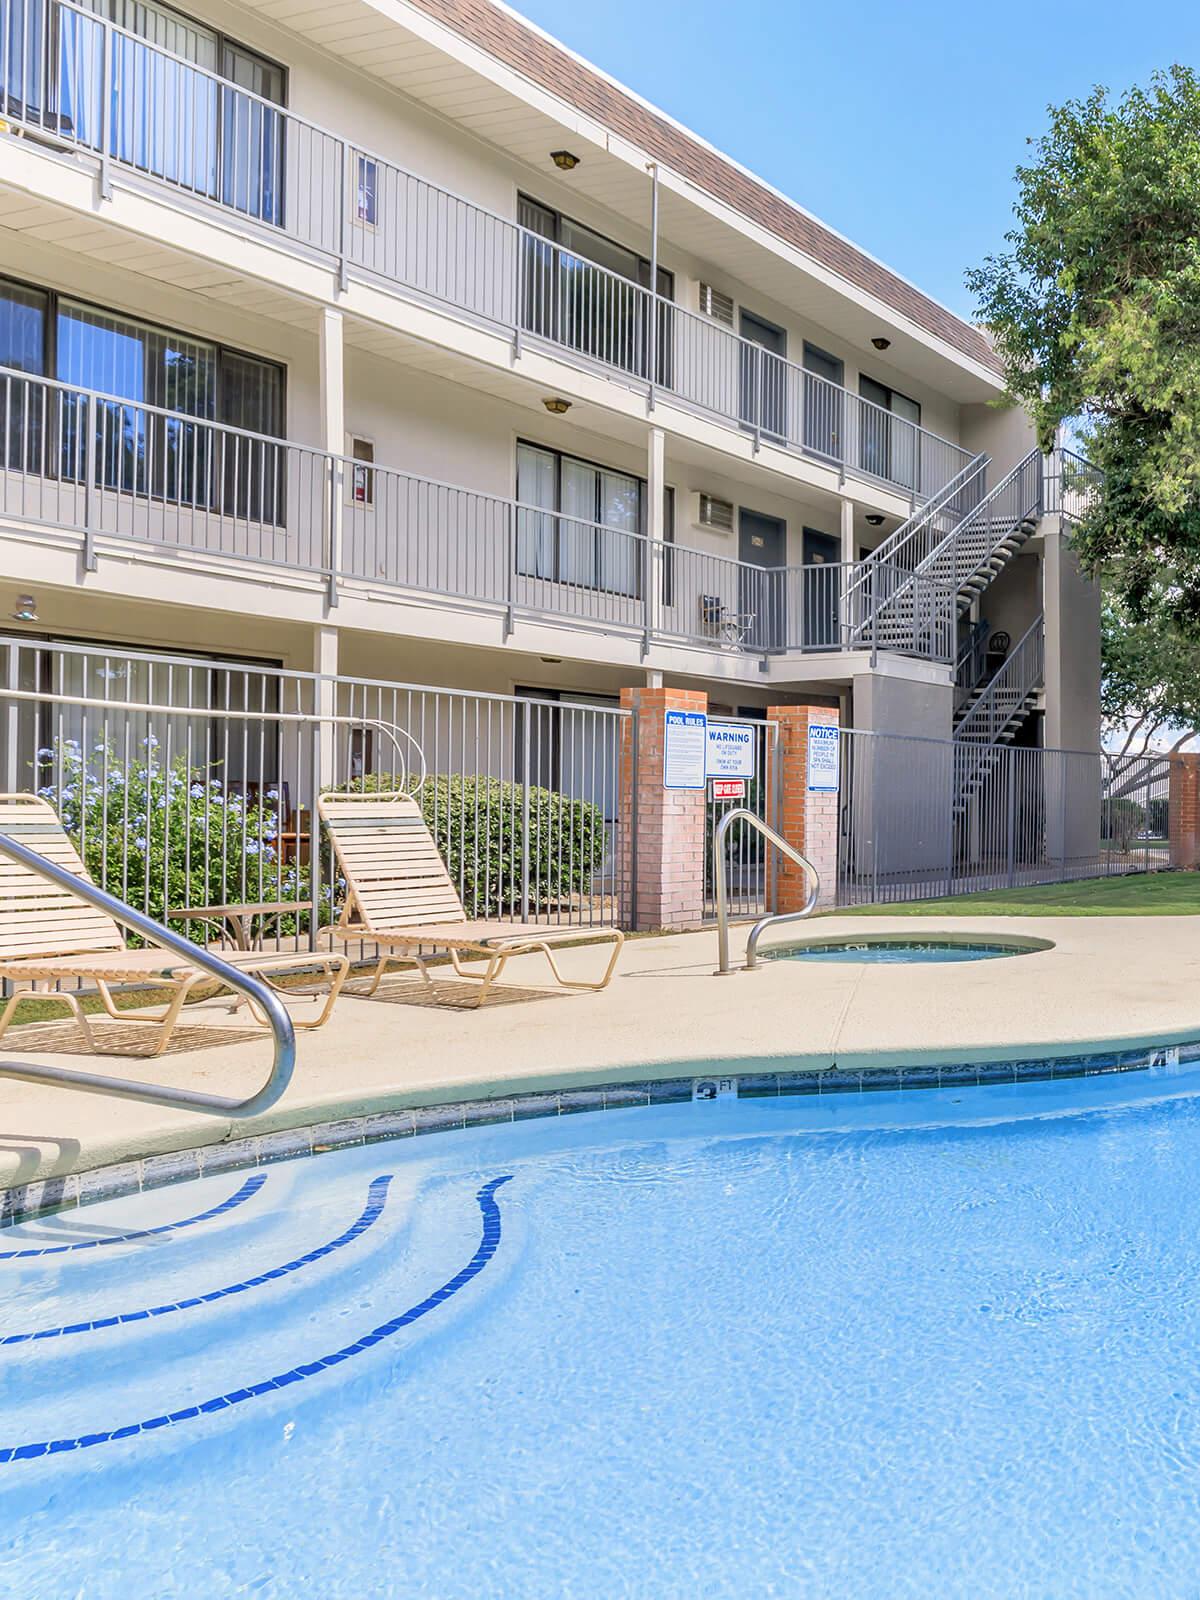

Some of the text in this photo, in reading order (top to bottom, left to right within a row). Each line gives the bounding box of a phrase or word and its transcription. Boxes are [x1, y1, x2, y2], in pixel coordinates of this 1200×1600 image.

[669, 716, 704, 727] POOL RULES
[708, 731, 750, 743] WARNING
[809, 727, 838, 739] NOTICE
[696, 1079, 732, 1100] 3 FT
